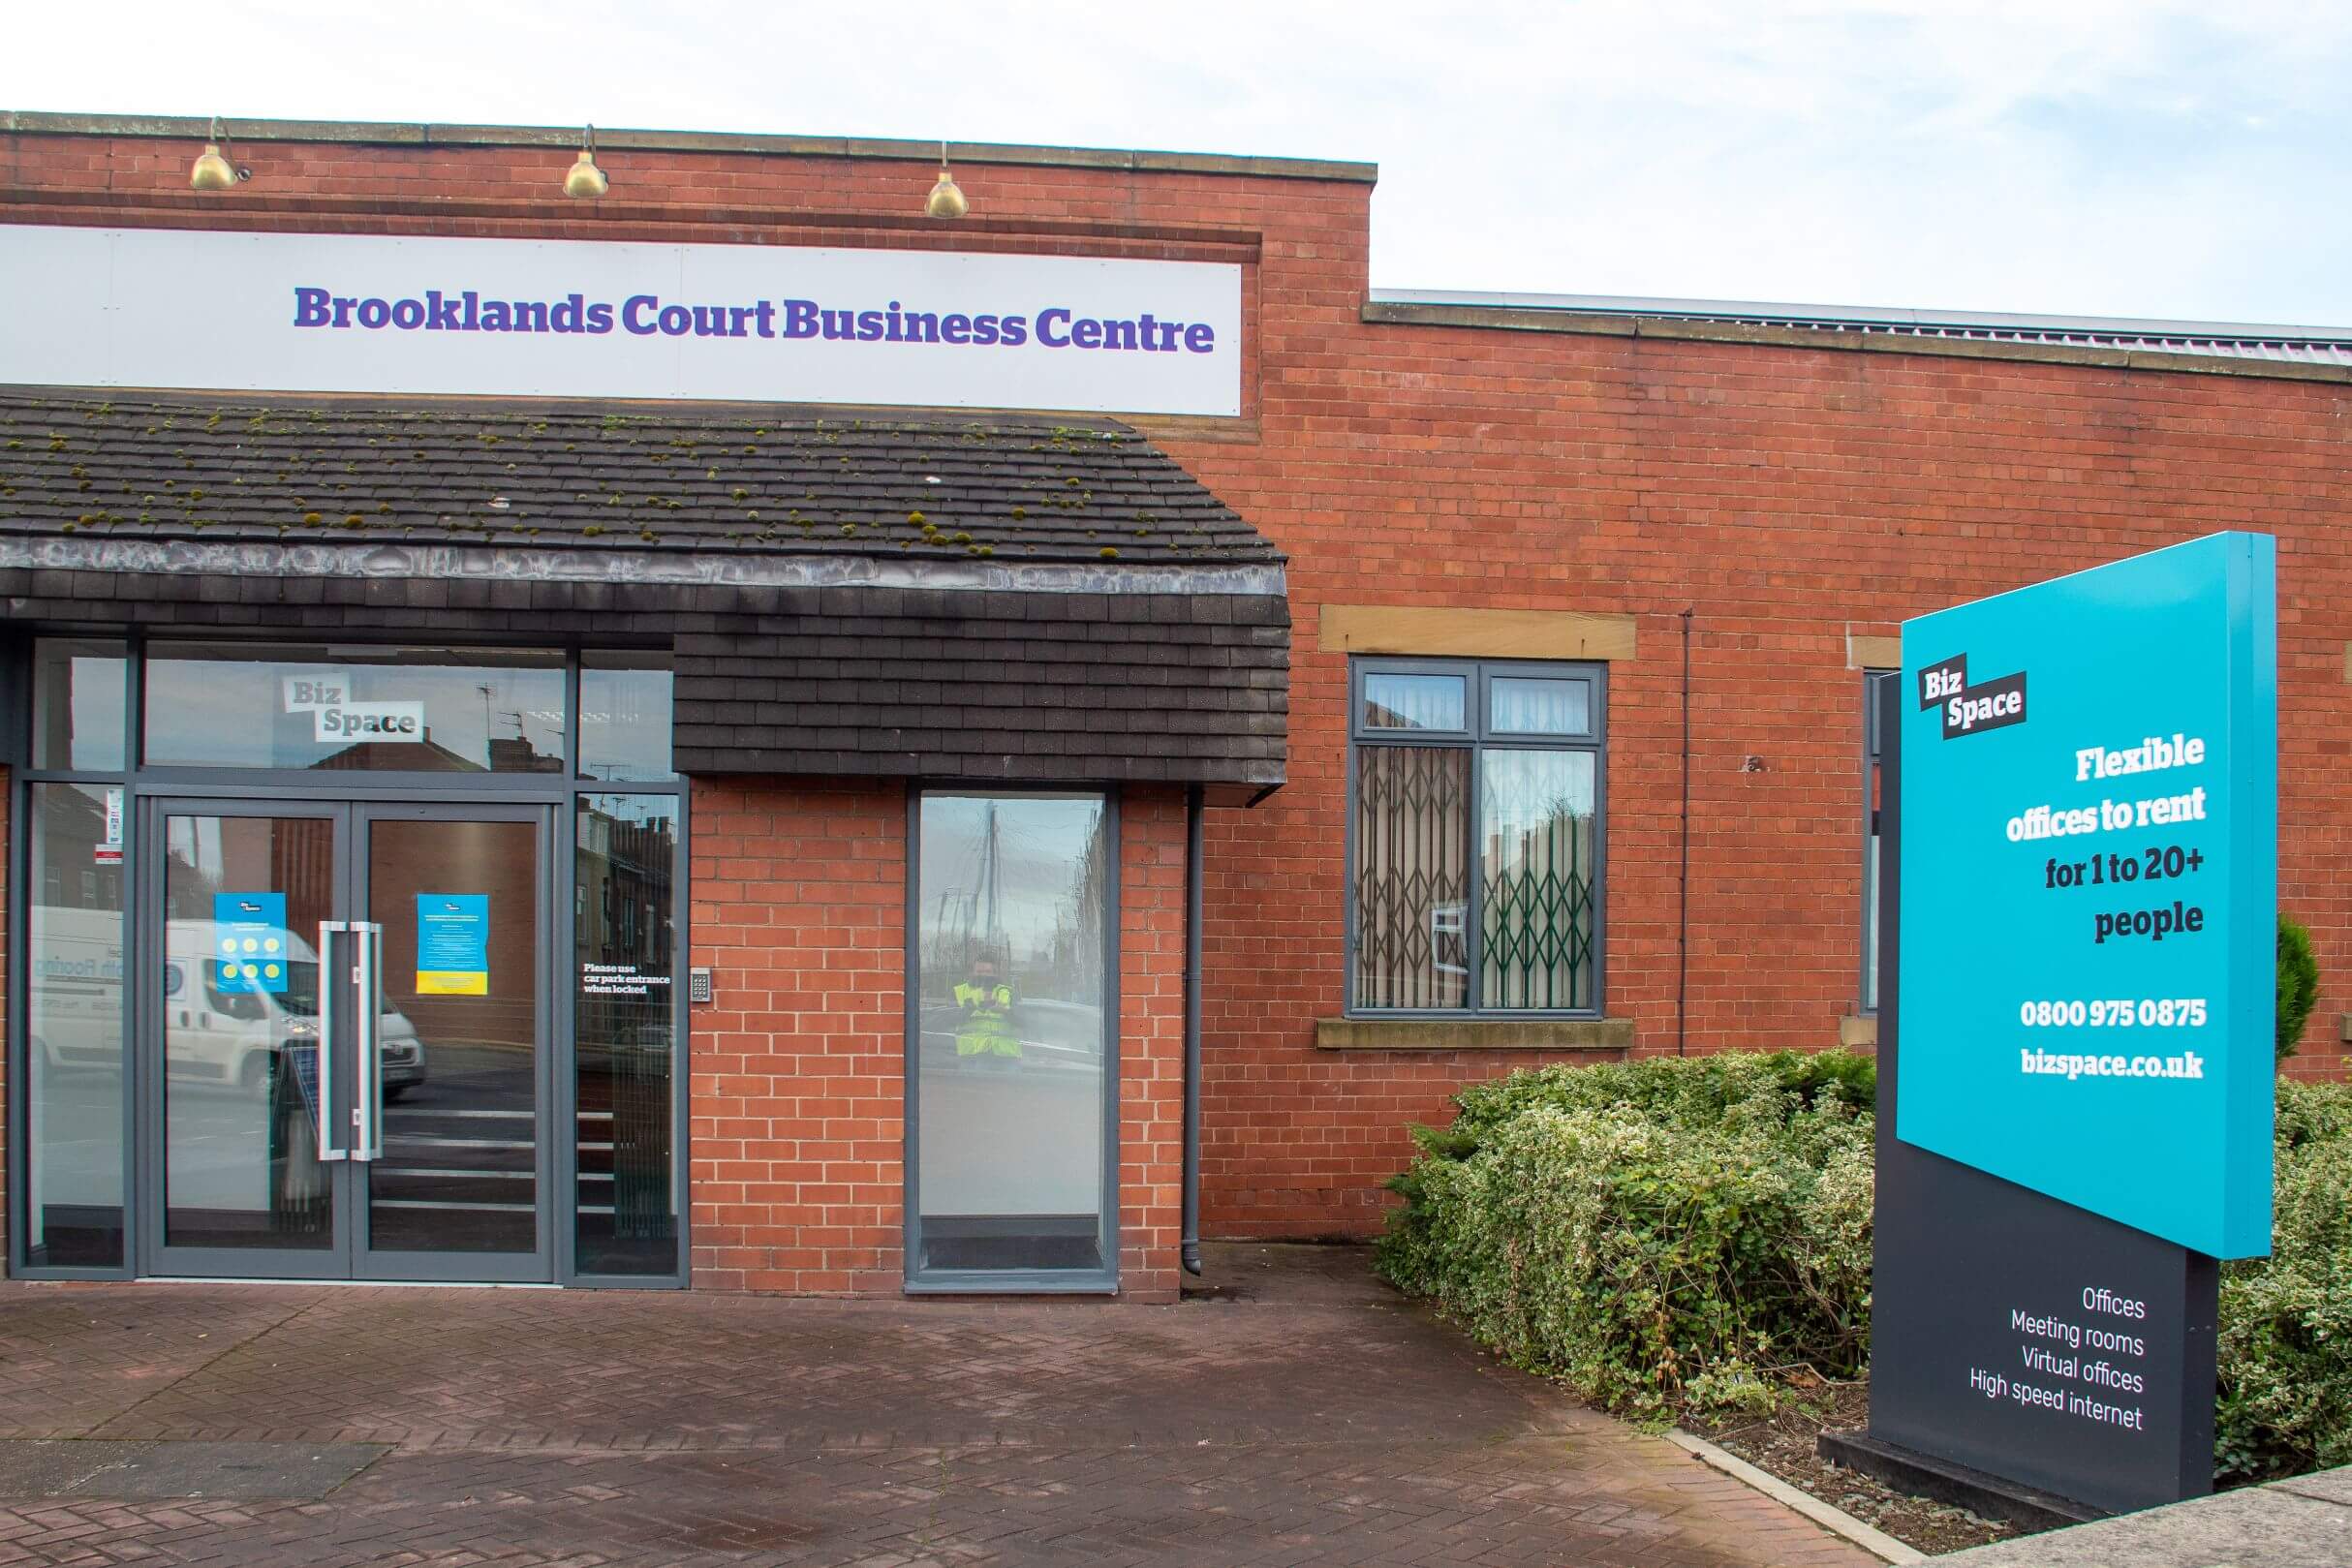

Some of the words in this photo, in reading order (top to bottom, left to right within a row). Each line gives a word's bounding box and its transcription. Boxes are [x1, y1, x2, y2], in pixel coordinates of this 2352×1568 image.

[294, 287, 613, 334] Brooklands
[622, 294, 775, 338] Court
[783, 299, 1027, 346] Business
[1036, 308, 1215, 354] Centre
[294, 682, 341, 704] Biz
[1925, 667, 1963, 700] Biz
[324, 708, 416, 736] Space
[1948, 691, 2023, 730] Space
[2075, 733, 2206, 782] Flexible
[2006, 805, 2098, 842] offices
[2100, 799, 2133, 831] to
[2136, 786, 2207, 827] rent
[2045, 858, 2087, 888] for
[2091, 853, 2104, 885] 1
[2108, 853, 2139, 883] to
[2144, 845, 2204, 880] 20+
[2094, 901, 2204, 943] people
[583, 964, 617, 972] Please
[601, 974, 625, 984] park
[625, 975, 670, 984] entrance
[584, 984, 612, 993] when
[612, 985, 647, 994] locked
[2020, 1000, 2087, 1027] 0800
[2089, 1000, 2135, 1027] 975
[2138, 999, 2207, 1027] 0875
[2020, 1048, 2204, 1080] bizspace.co.uk
[2083, 1286, 2145, 1318] Offices
[2011, 1308, 2080, 1348] Meeting
[2086, 1328, 2145, 1356] rooms
[2022, 1344, 2078, 1378] Virtual
[2083, 1361, 2144, 1393] offices
[1970, 1367, 2007, 1399] High
[2012, 1382, 2063, 1410] speed
[2069, 1391, 2143, 1430] internet
